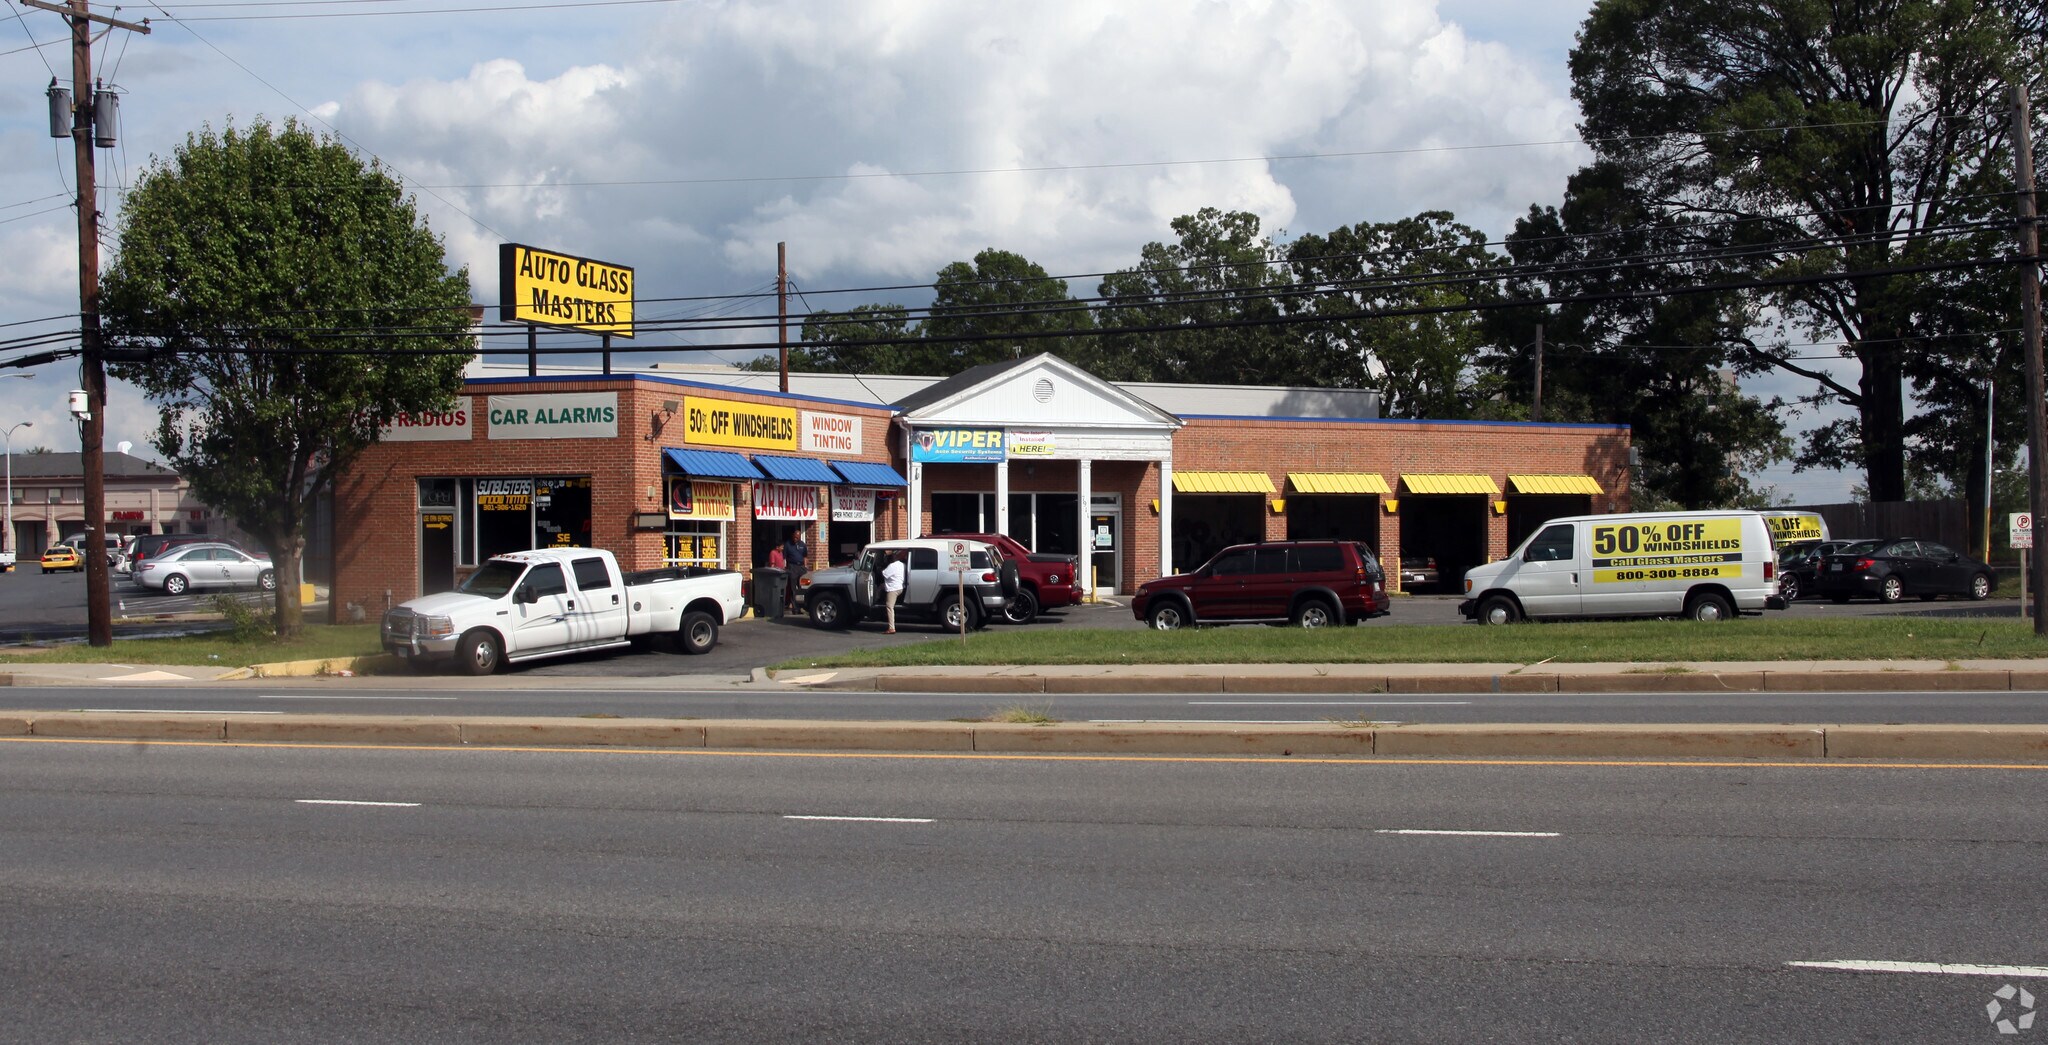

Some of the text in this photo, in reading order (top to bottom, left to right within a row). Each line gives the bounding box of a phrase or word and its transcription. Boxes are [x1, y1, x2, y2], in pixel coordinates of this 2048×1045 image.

[520, 248, 629, 295] AUTO GLASS
[531, 287, 617, 326] MASTERS
[490, 407, 615, 425] CAR ALARMS
[690, 408, 793, 441] 50% OFF WINDSHIELDS
[812, 416, 852, 433] WINDOW
[813, 434, 852, 450] TINTING
[933, 430, 1003, 448] VIPER
[477, 480, 532, 495] SUNBUSTERS
[693, 482, 731, 498] WINDOW
[697, 498, 730, 516] TINTING
[754, 482, 815, 517] CAR RADIOS
[839, 499, 868, 511] SOLD HERE
[1782, 517, 1801, 530] OFF
[557, 533, 571, 543] SE
[1595, 523, 1705, 554] 50% OFF
[1774, 530, 1821, 539] WINDSHIELDS
[1643, 539, 1740, 552] WINDSHIELDS
[1610, 554, 1724, 567] Call Glass Masters
[1617, 568, 1719, 580] 800-300-8884
